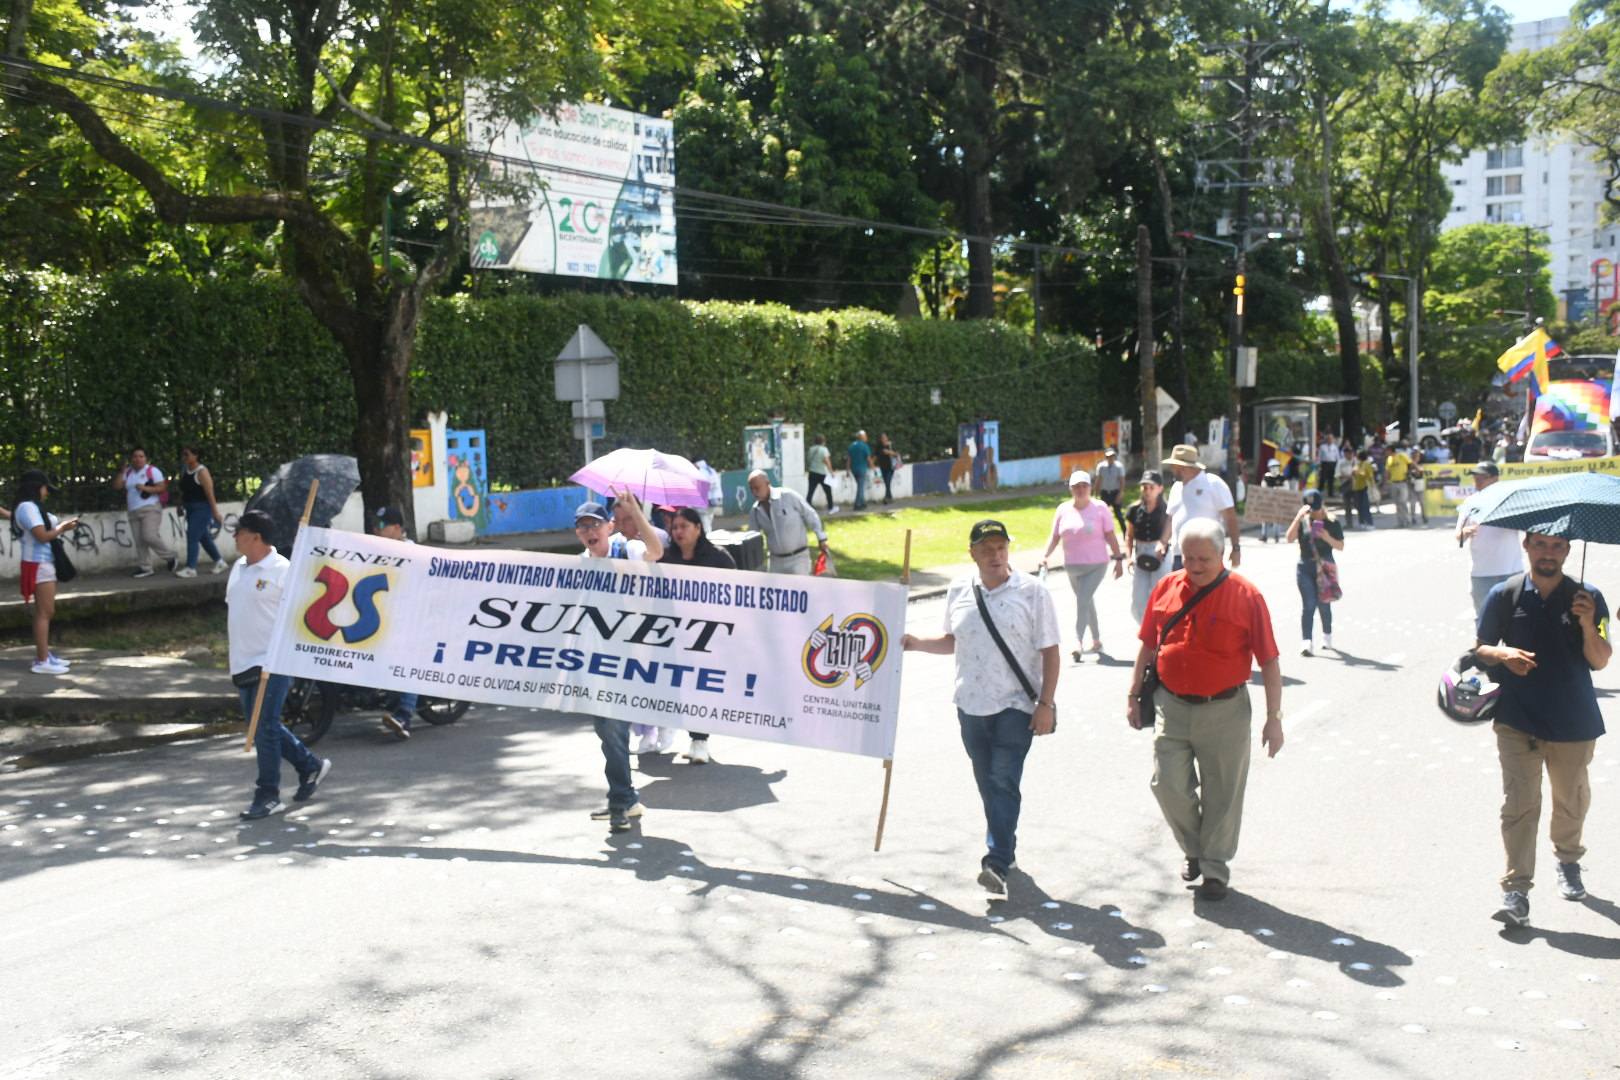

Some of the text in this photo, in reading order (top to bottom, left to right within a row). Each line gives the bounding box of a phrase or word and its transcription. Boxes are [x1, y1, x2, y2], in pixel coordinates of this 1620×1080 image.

[309, 545, 412, 568] SUNET
[429, 556, 808, 614] SINDICATO UNITARIO NACIONAL DE TRABAJADORES DEL ESTADO
[468, 597, 735, 653] SUNET
[294, 643, 375, 662] SUBDIRECTIVA
[313, 657, 354, 670] TOLIMA
[463, 639, 727, 694] PRESENTE
[409, 668, 456, 684] PUEBLO
[458, 674, 481, 688] QUE
[523, 680, 538, 693] SU
[539, 681, 593, 700] HISTORIA,
[596, 689, 628, 706] ESTA
[631, 696, 708, 718] CONDENADO
[709, 708, 719, 719] A
[803, 694, 882, 712] CENTRAL UNITARIA
[803, 706, 881, 724] DE TRABAJADORES
